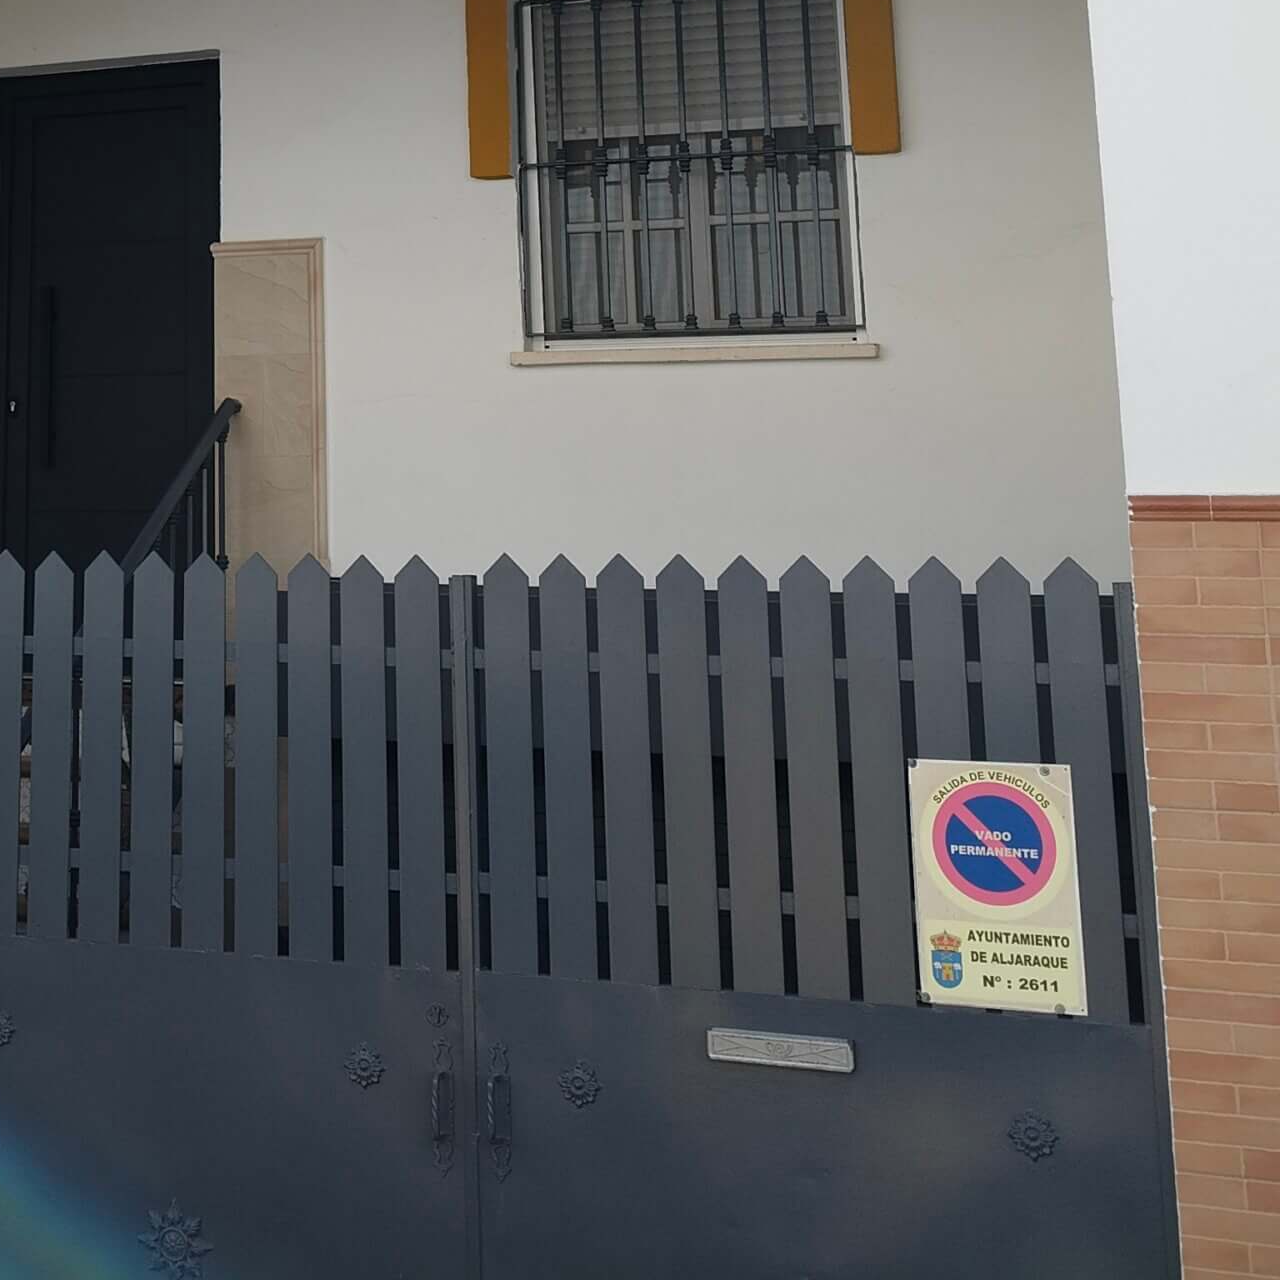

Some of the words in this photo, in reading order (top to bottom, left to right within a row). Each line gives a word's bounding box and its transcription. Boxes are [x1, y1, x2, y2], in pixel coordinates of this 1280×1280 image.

[932, 774, 968, 805] SALIDA
[968, 770, 986, 782] DE
[987, 770, 1051, 809] VEHICULOS
[975, 830, 1012, 842] VADO
[950, 844, 1039, 859] PERMANENTE
[967, 929, 1070, 948] AYUNTAMIENTO
[970, 950, 987, 963] DE
[991, 952, 1069, 969] ALJARAQUE
[1019, 977, 1059, 993] 2611
